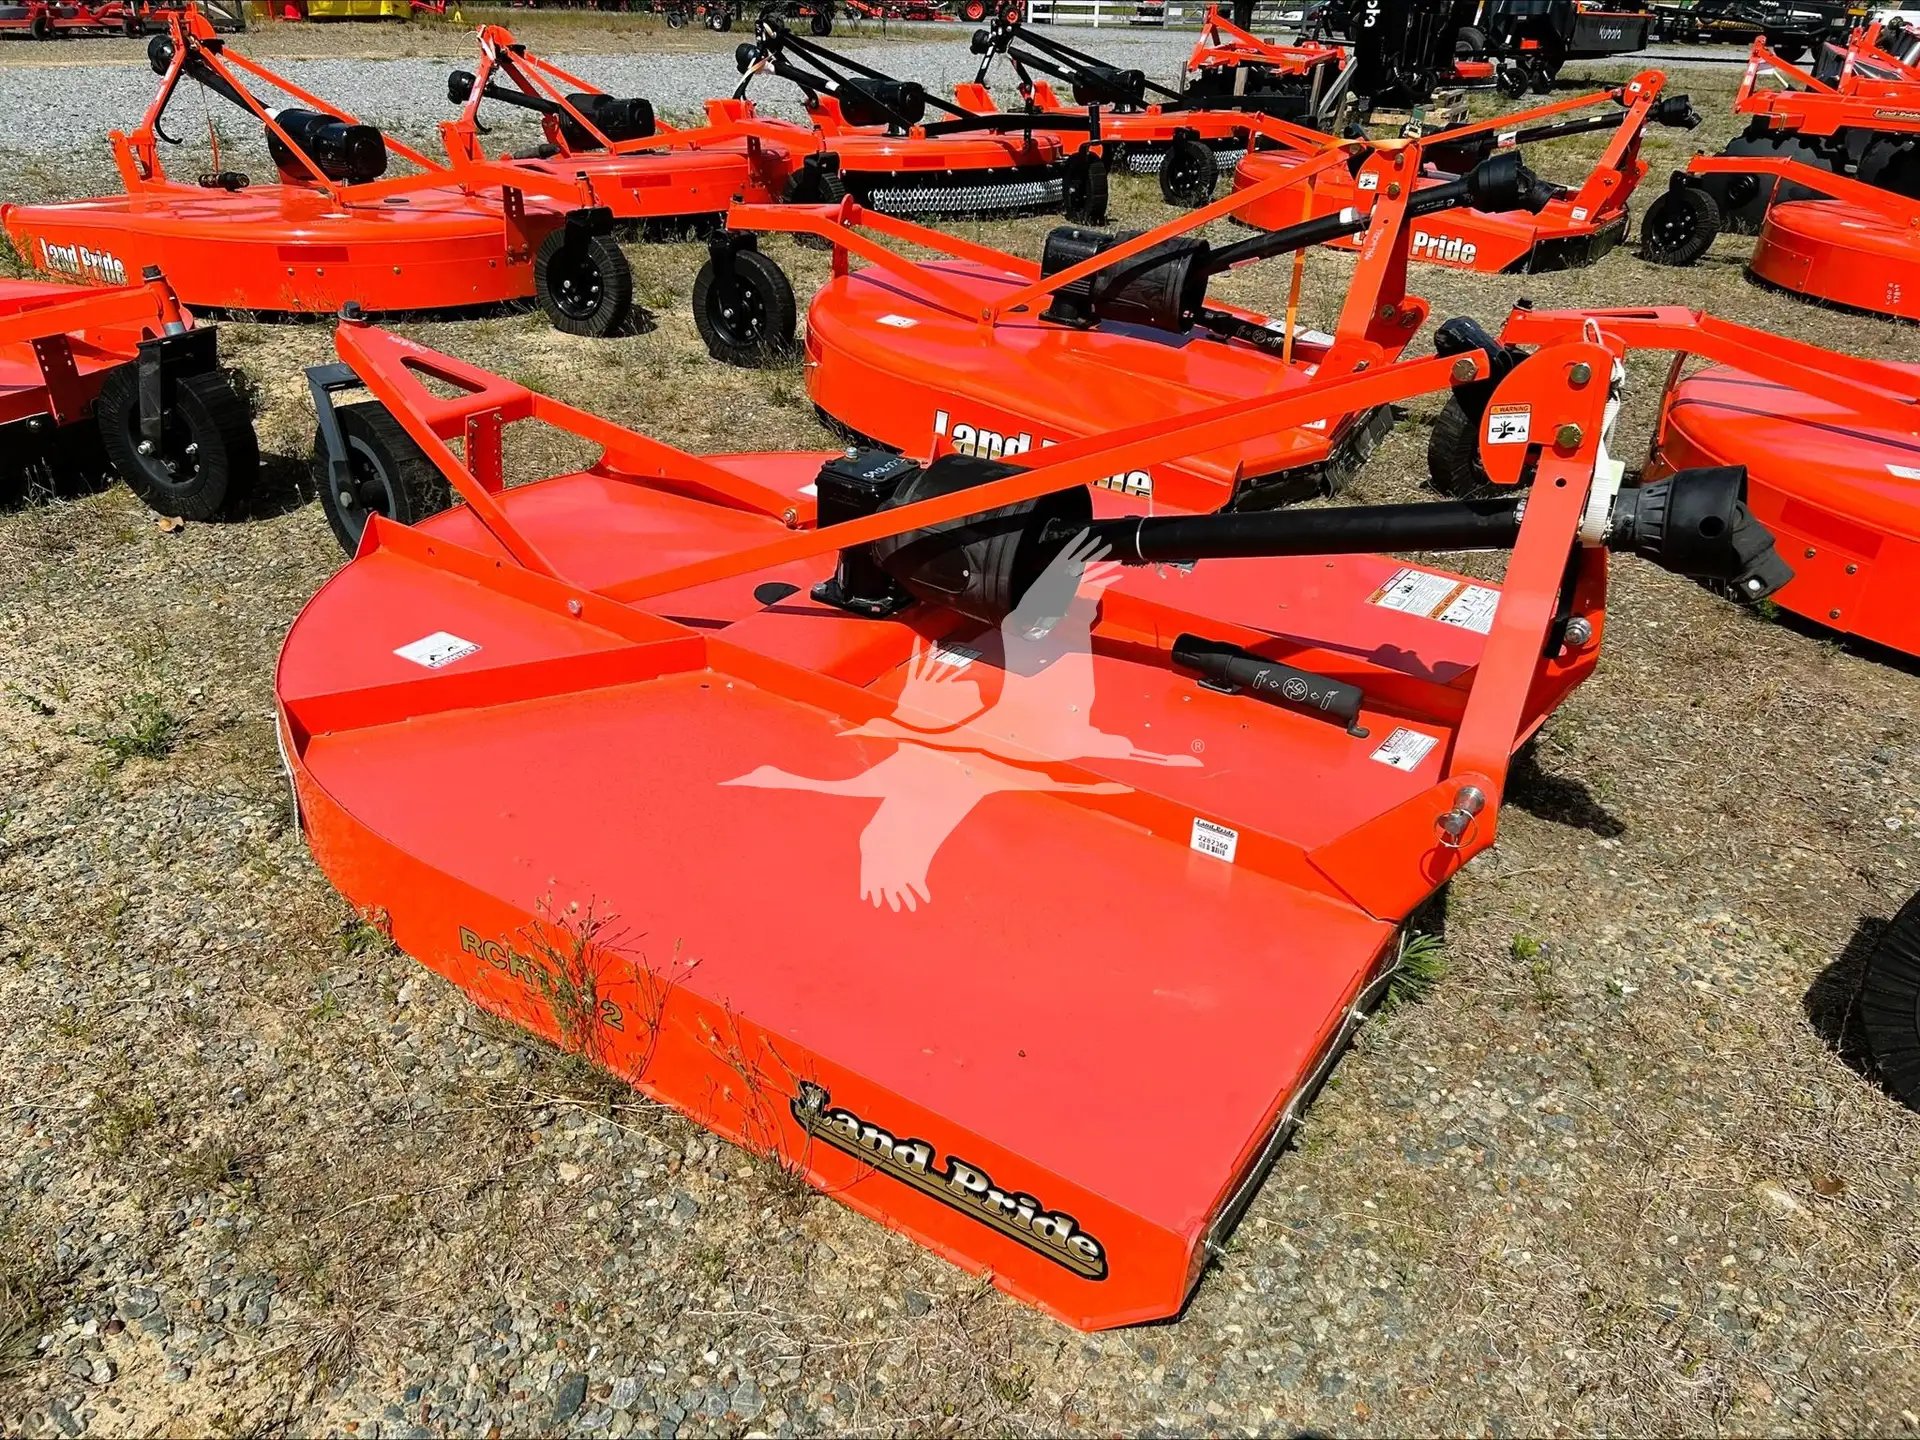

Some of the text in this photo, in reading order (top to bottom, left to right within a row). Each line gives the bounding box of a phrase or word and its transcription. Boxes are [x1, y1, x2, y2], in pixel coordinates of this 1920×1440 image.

[1599, 24, 1622, 40] Kubota
[39, 236, 128, 287] Land Pride
[1410, 230, 1478, 265] Pride
[1195, 819, 1216, 831] Land
[793, 1082, 1101, 1262] Land Pride
